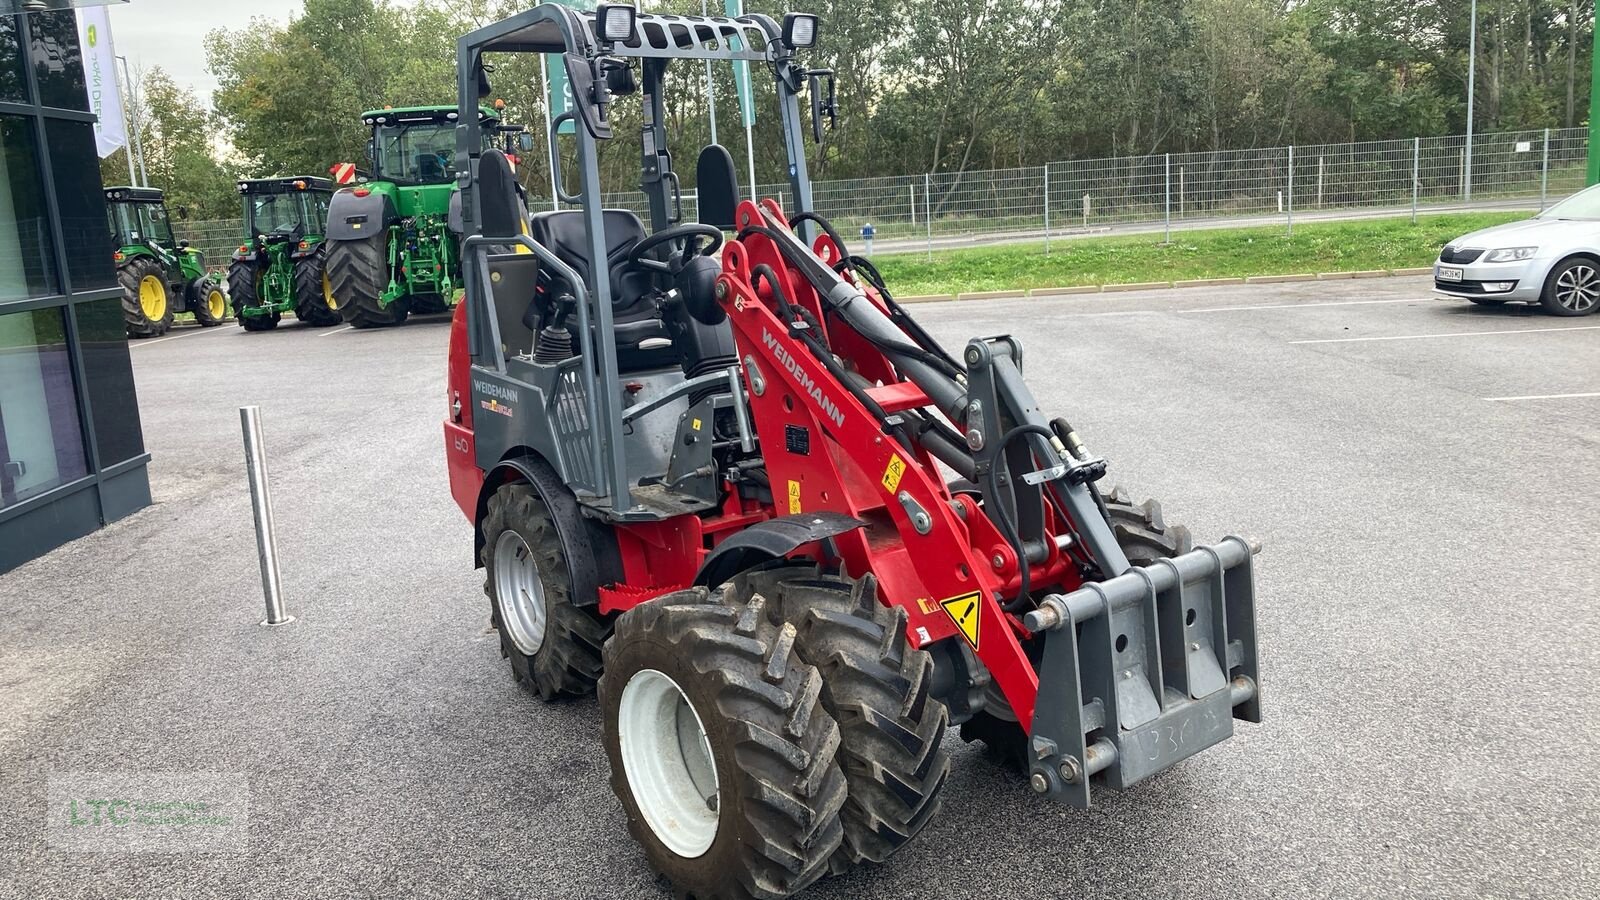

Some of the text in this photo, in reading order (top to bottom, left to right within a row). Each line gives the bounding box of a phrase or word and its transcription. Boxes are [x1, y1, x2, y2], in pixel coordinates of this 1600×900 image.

[91, 53, 102, 87] JOHN
[474, 379, 519, 403] WEIDEMANN
[762, 326, 845, 428] WEIDEMANN
